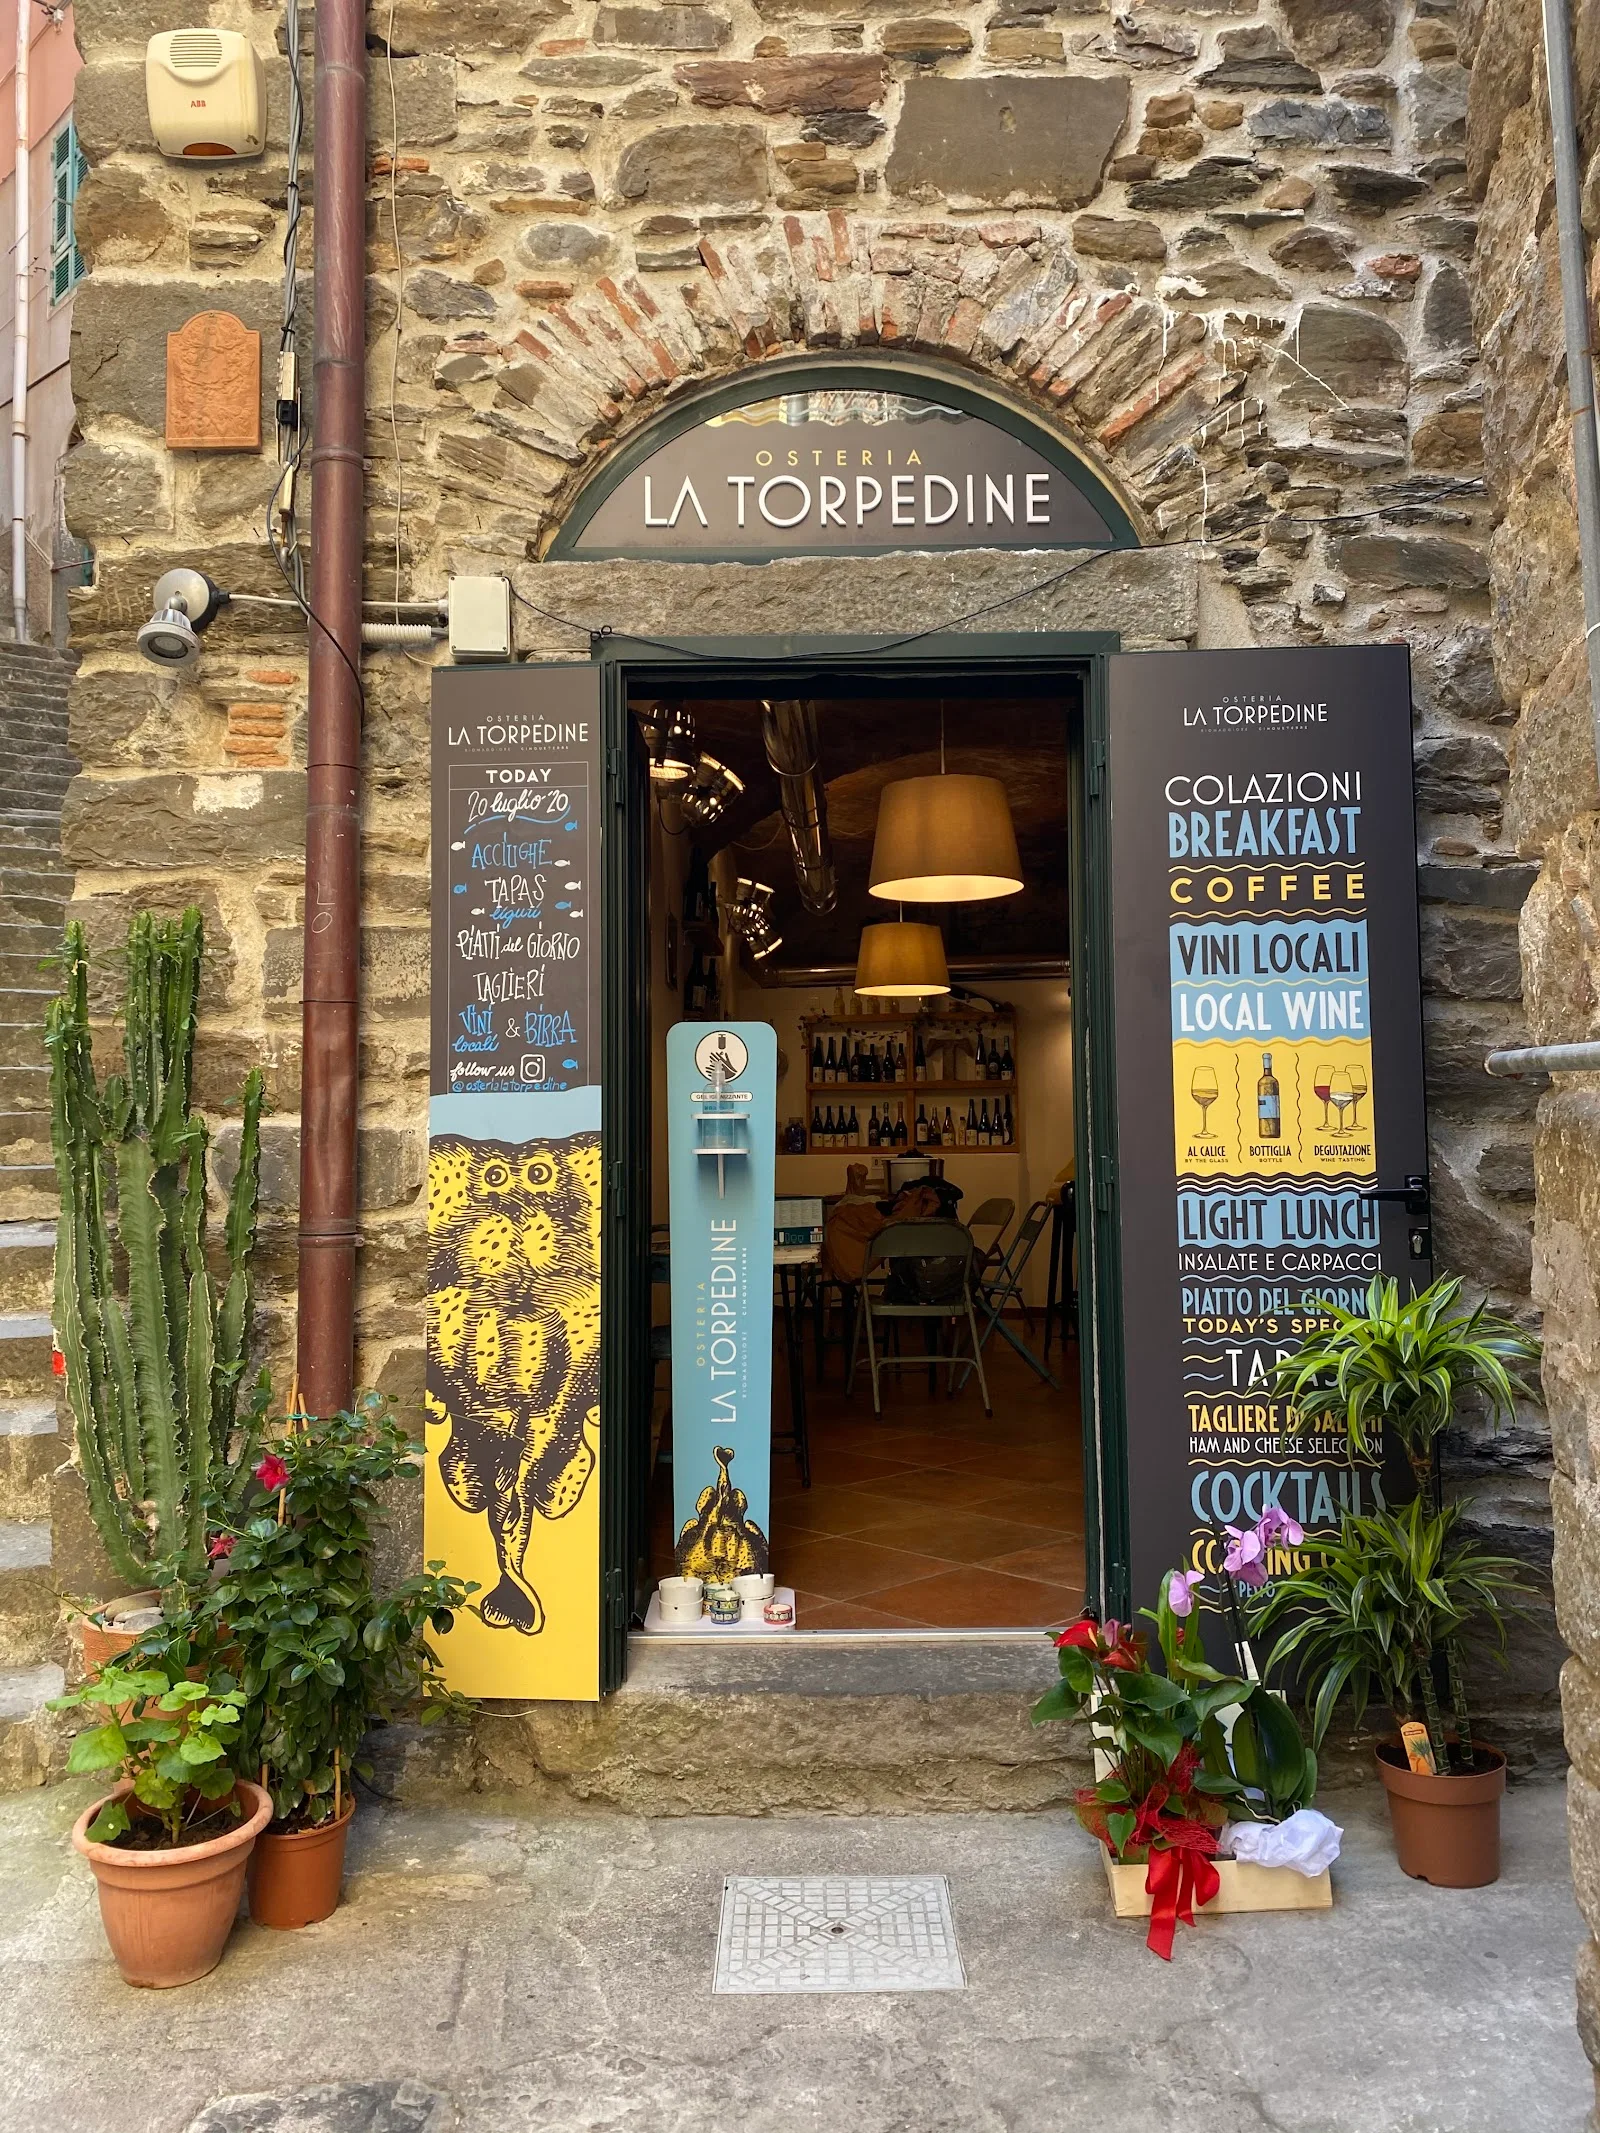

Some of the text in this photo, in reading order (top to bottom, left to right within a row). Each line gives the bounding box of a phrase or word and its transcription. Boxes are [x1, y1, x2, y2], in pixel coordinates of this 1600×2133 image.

[190, 100, 206, 108] ABB
[755, 449, 923, 467] OSTERIA
[644, 473, 1051, 528] LA TORPEDINE
[1222, 695, 1282, 704] OSTERIA
[486, 714, 545, 722] OSTERIA
[1183, 703, 1328, 726] LA TORPEDINE
[448, 723, 589, 745] LA TORPEDINE
[486, 768, 552, 784] TODAY
[1164, 771, 1361, 807] COLAZIONI
[468, 790, 488, 822] 20
[1168, 807, 1361, 858] BREAKFAST
[471, 832, 553, 870] ACCIUGHE
[484, 873, 547, 908] TAPAS
[1170, 873, 1366, 904] COFFEE
[455, 921, 580, 960] PIATTI del GIORNO
[1177, 931, 1360, 976] VINI LOCALI
[473, 963, 545, 1005] TAGLIERI
[1180, 990, 1364, 1032] LOCAL WINE
[459, 1003, 577, 1048] VINI & BIRRA
[452, 1034, 499, 1052] locali
[450, 1062, 515, 1081] follow us
[1187, 1146, 1226, 1157] AL CALICE
[1249, 1145, 1292, 1157] BOTTIGLIA
[1314, 1144, 1372, 1156] DEGUSTAZIONE
[1182, 1198, 1376, 1240] LIGHT LUNCH
[1178, 1253, 1382, 1271] INSALATE E CARPACCI
[1182, 1287, 1366, 1315] PIATTO DEL GIORN
[696, 1282, 706, 1367] OSTERIA
[711, 1219, 737, 1423] LA TORPEDINE
[1182, 1318, 1279, 1334] TODAY'S
[1188, 1404, 1280, 1433] TAGLIERE
[1189, 1437, 1221, 1453] HAM
[1223, 1437, 1250, 1453] AND
